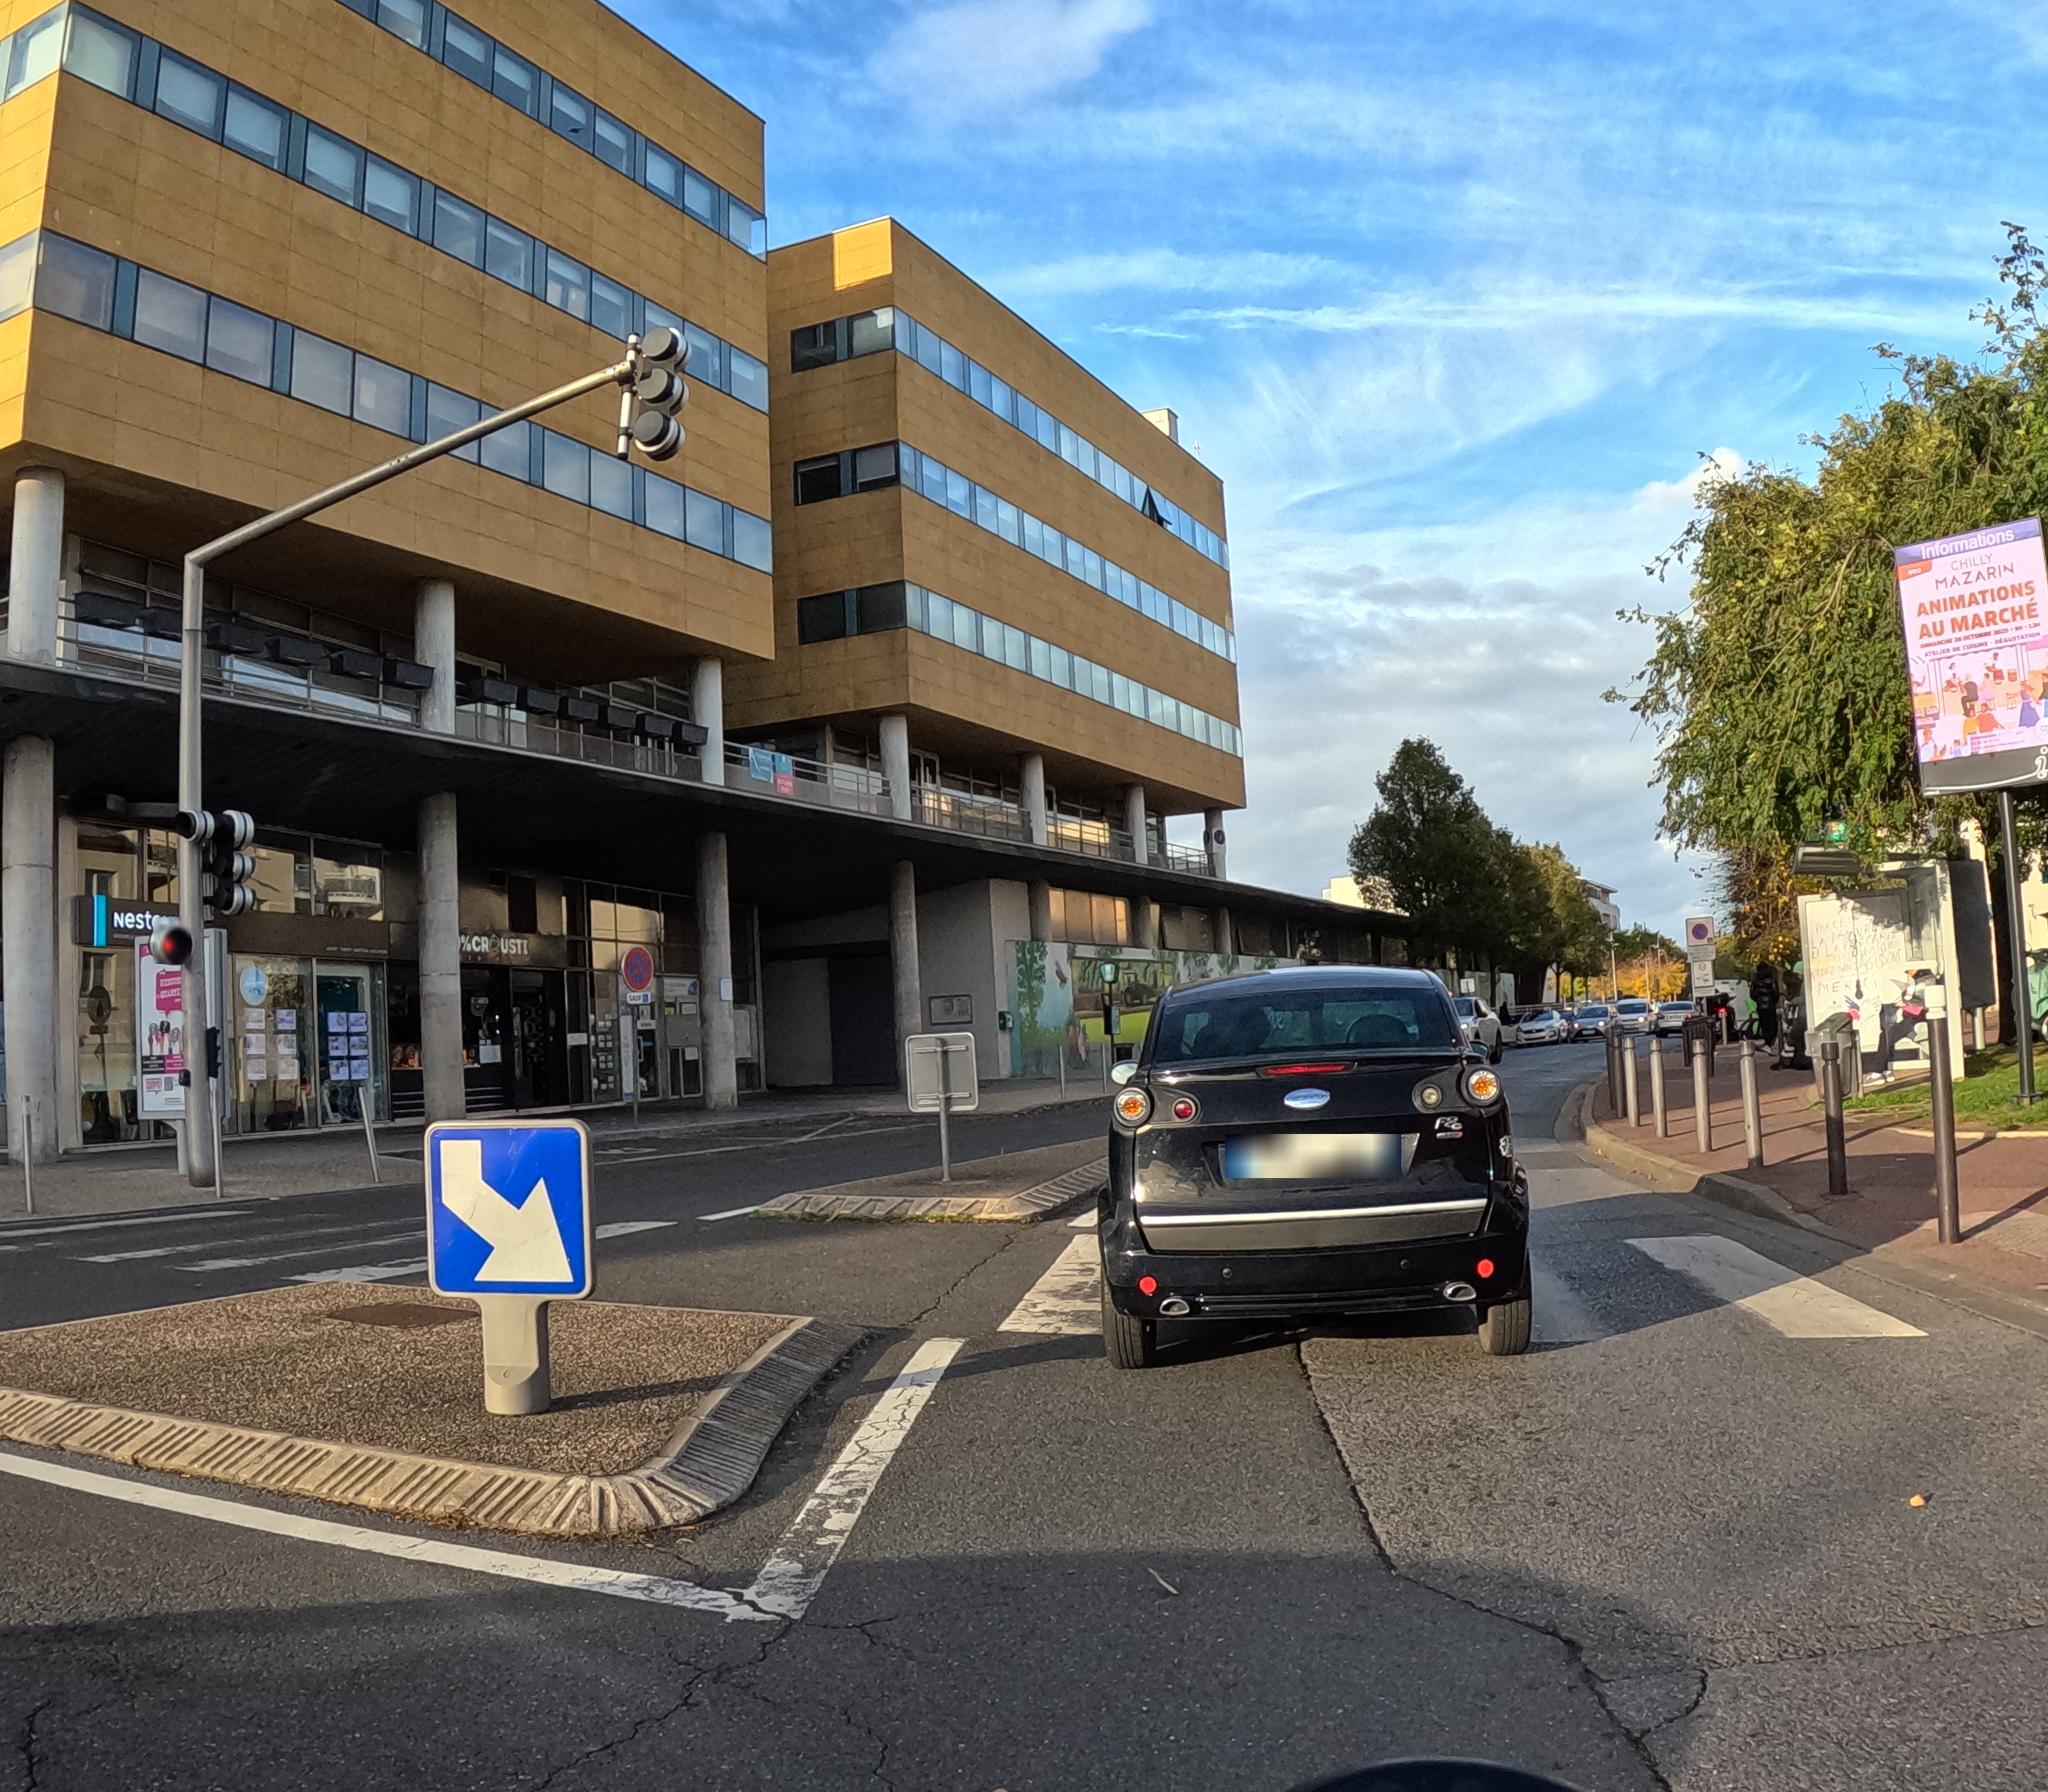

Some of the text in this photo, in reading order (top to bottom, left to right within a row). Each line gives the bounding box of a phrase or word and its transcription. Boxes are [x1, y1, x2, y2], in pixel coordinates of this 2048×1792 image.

[1921, 530, 2015, 559] Informations
[1935, 562, 2015, 590] MAZARIN
[1951, 553, 1993, 571] CHILLY
[1917, 580, 2036, 617] ANIMATIONS
[1919, 598, 2039, 640] AU MARCHÉ
